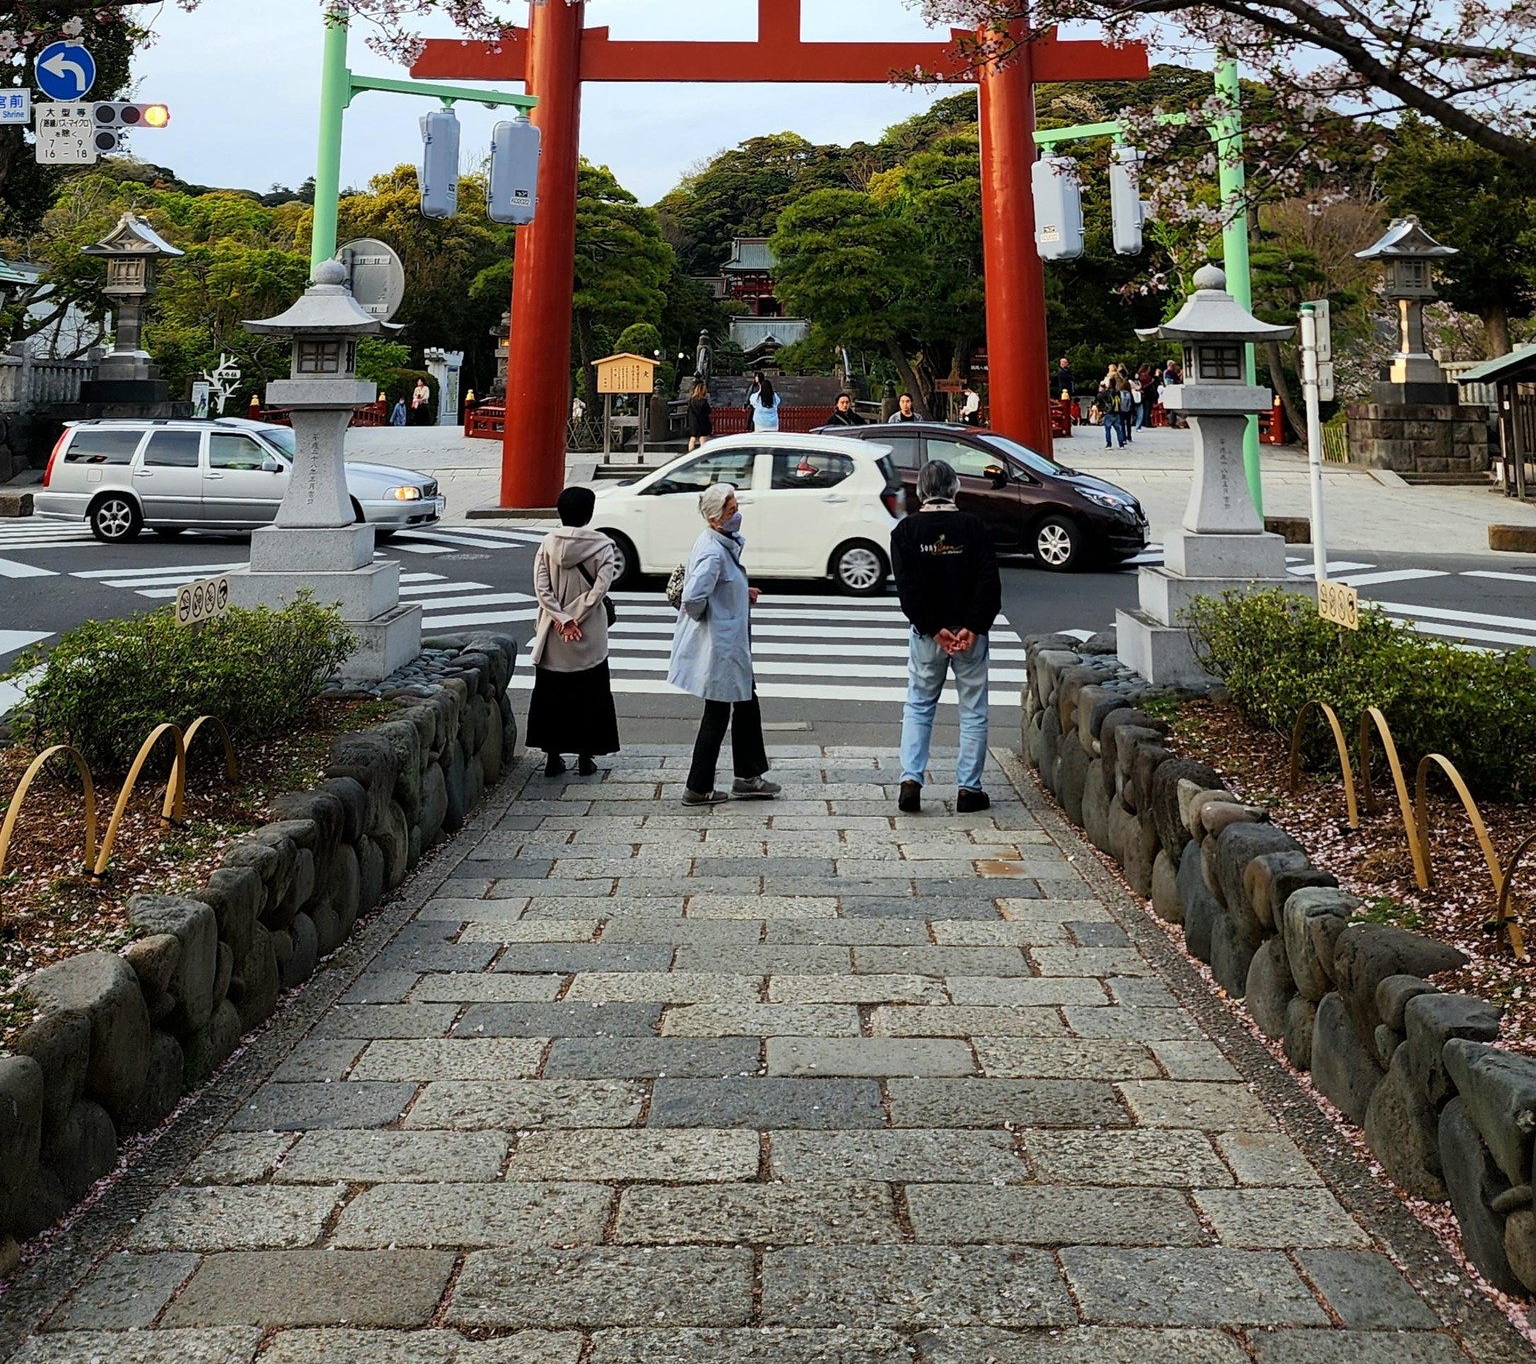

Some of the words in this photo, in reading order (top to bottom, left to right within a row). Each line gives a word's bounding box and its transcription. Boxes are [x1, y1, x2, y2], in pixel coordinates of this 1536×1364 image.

[2, 110, 24, 118] Shrine
[55, 129, 77, 138] を除く
[49, 139, 55, 148] 7
[77, 139, 83, 148] 9
[45, 149, 56, 158] 16
[76, 149, 87, 158] 18
